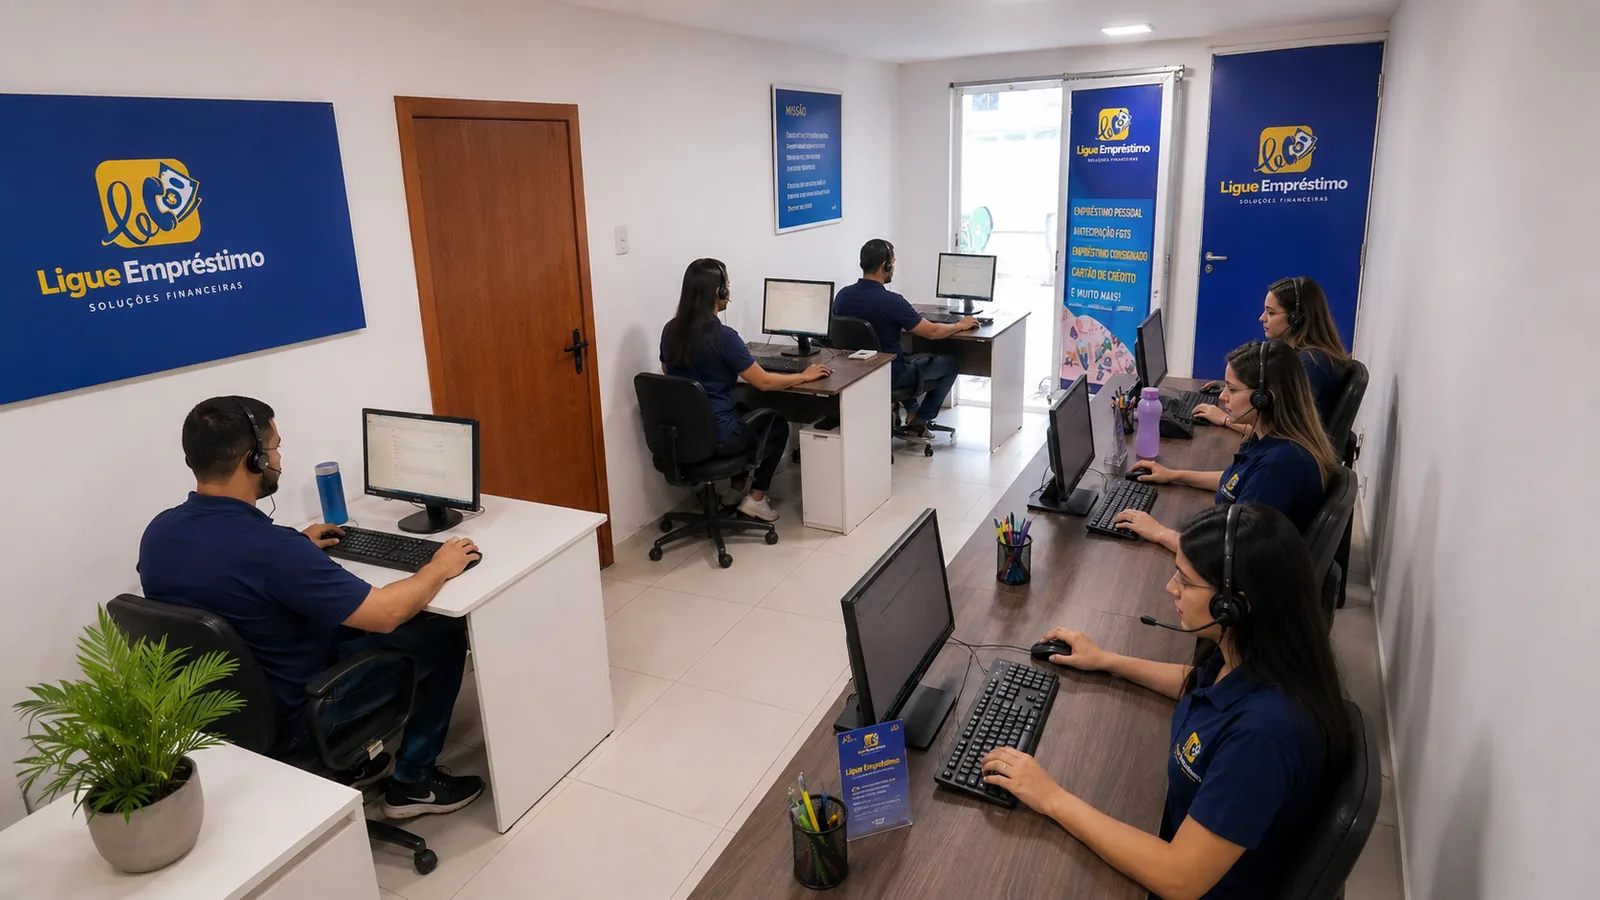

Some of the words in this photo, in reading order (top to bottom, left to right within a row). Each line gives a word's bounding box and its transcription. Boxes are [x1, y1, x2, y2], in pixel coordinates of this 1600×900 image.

[1076, 145, 1099, 157] Ligue
[1100, 143, 1151, 156] Empréstimo
[1220, 180, 1259, 196] Ligue
[1261, 177, 1348, 194] Empréstimo
[1114, 208, 1143, 218] PESSOAL
[36, 267, 122, 299] Ligue
[123, 248, 266, 285] Empréstimo
[1071, 267, 1097, 280] CARTÃO
[1097, 270, 1107, 280] DE
[1107, 269, 1137, 284] CRÉDITO
[88, 293, 161, 313] SOLUÇÕES
[165, 281, 244, 301] FINANCEIRAS
[1077, 289, 1099, 300] MUITO
[1100, 291, 1121, 302] MAIS!
